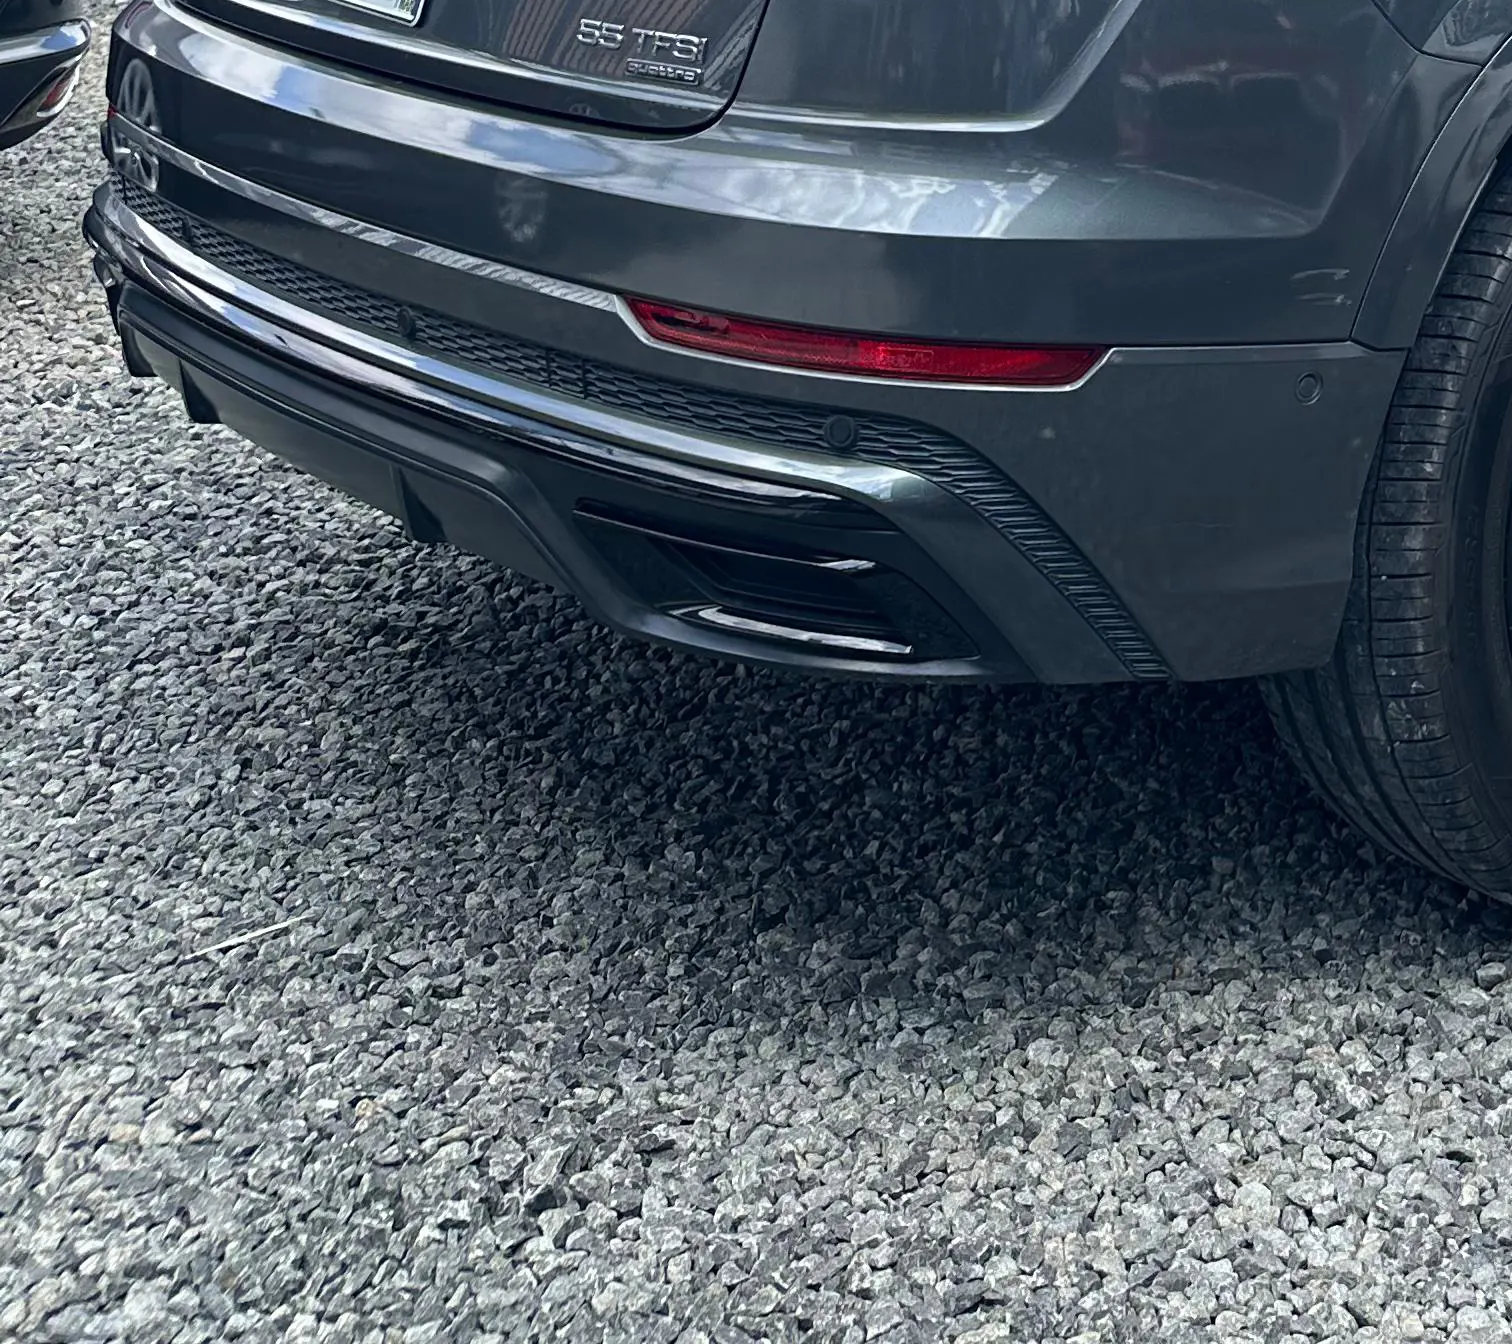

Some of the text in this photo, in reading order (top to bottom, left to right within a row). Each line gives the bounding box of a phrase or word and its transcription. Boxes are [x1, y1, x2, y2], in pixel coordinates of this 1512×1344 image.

[576, 18, 708, 63] 55 TFSI
[626, 61, 698, 82] quattro
